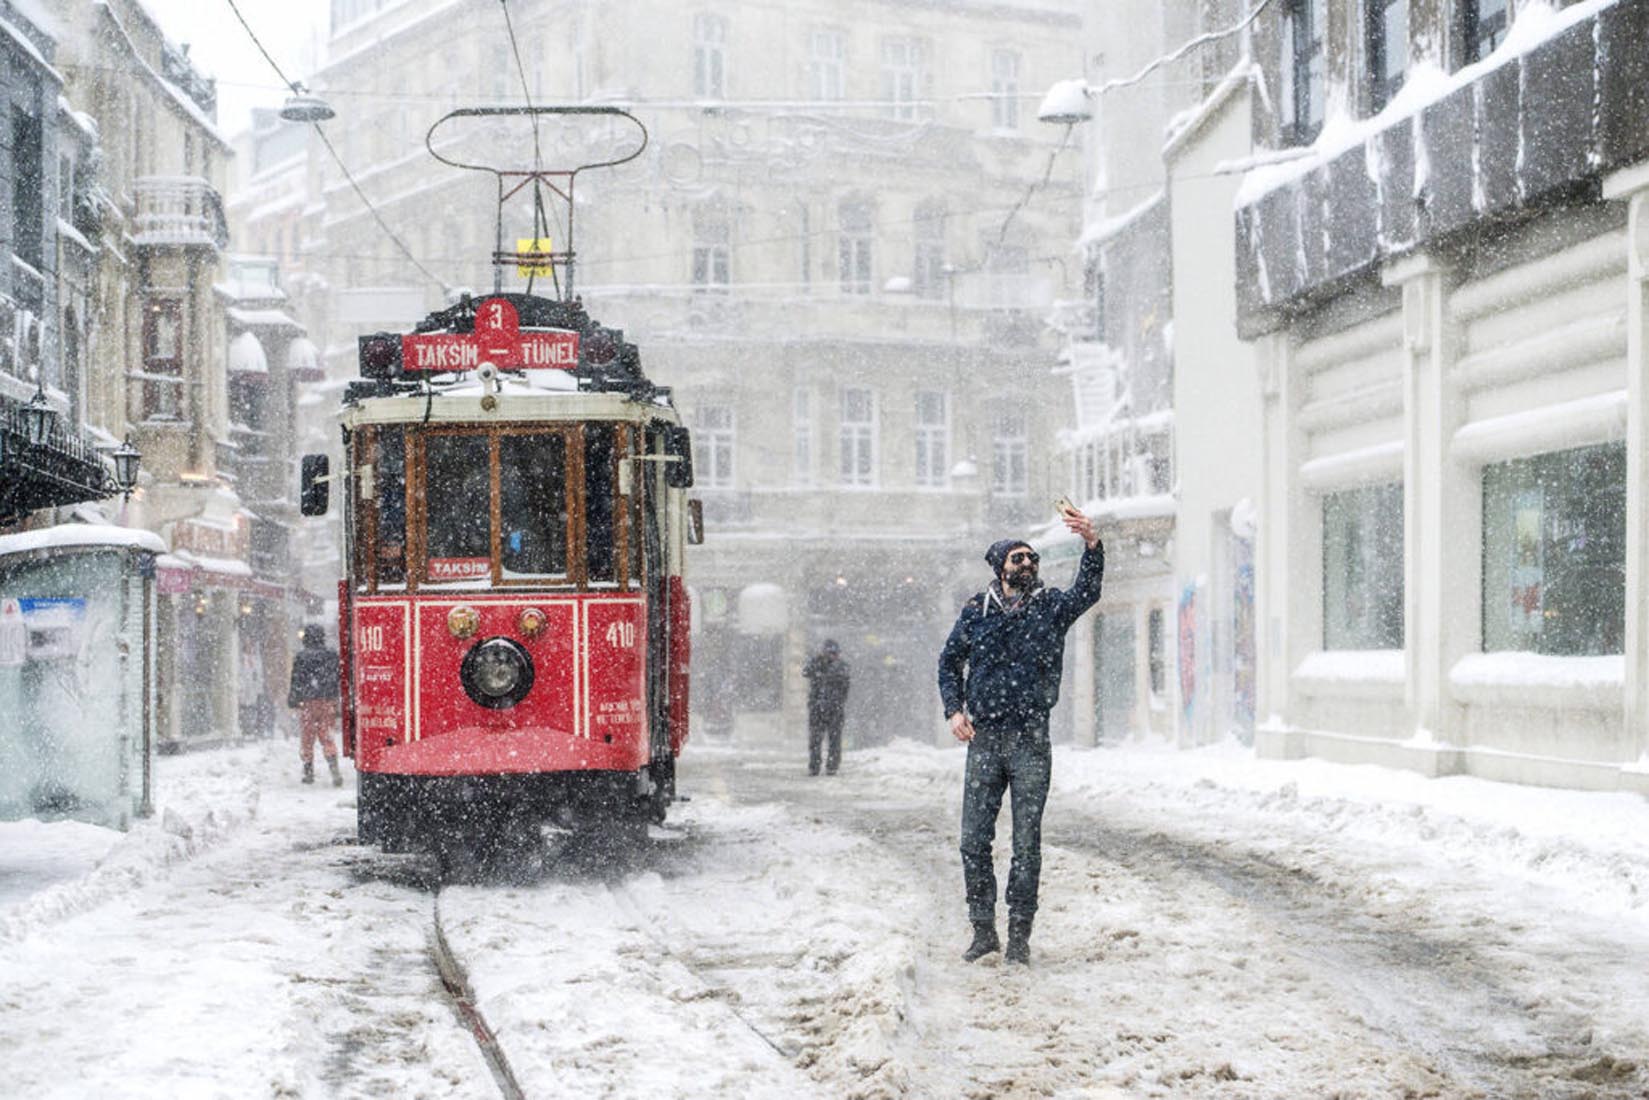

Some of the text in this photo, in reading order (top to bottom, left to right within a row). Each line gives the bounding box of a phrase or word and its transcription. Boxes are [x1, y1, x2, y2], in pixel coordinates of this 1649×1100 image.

[490, 303, 503, 329] 3
[521, 338, 578, 365] TÜNEL
[605, 620, 634, 648] 410
